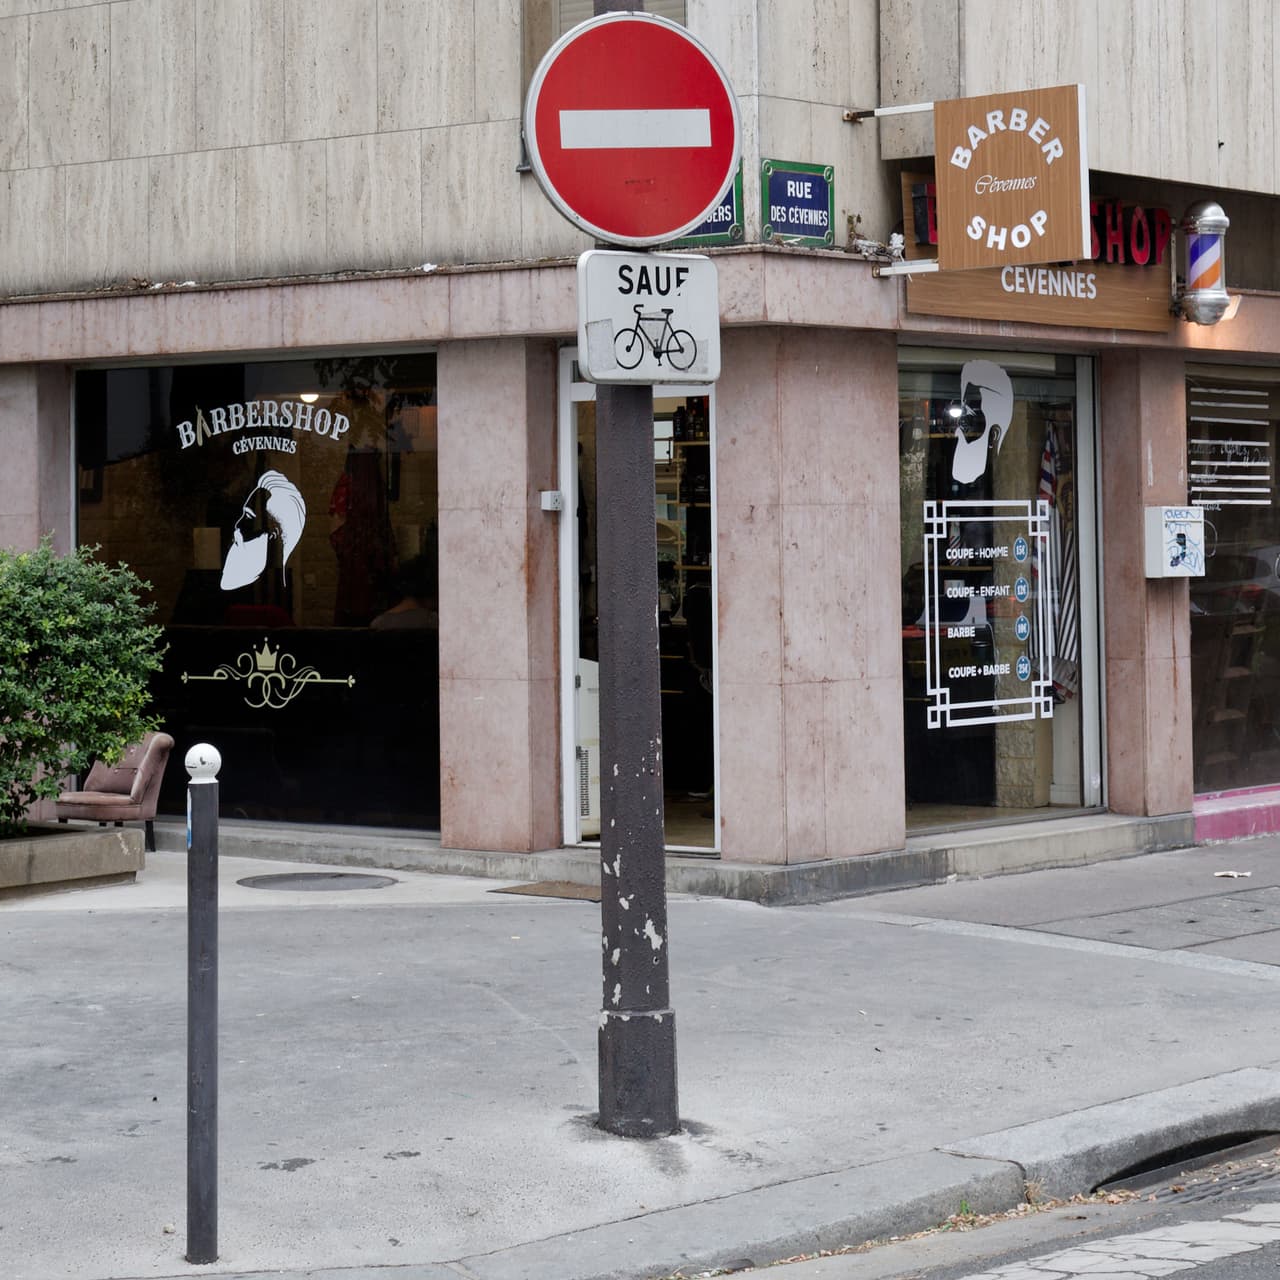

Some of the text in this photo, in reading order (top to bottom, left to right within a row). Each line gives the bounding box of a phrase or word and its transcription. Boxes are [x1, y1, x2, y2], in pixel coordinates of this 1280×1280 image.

[950, 108, 1063, 170] BARBER
[787, 180, 813, 199] RUE
[974, 174, 1038, 195] Cévennes
[770, 205, 828, 227] DES CÉVENNES
[966, 209, 1048, 251] SHOP
[618, 264, 689, 296] SAUF
[1001, 266, 1097, 300] CEVENNES
[176, 400, 350, 450] BARBERSHOP
[232, 436, 297, 455] CÉVENNES
[946, 548, 974, 559] COUPE
[979, 546, 1009, 559] HOMME
[946, 586, 975, 598] COUPE
[980, 585, 1010, 597] ENFANT
[947, 626, 976, 638] BARBE
[948, 666, 977, 678] COUPE
[983, 664, 1011, 676] BARBE
